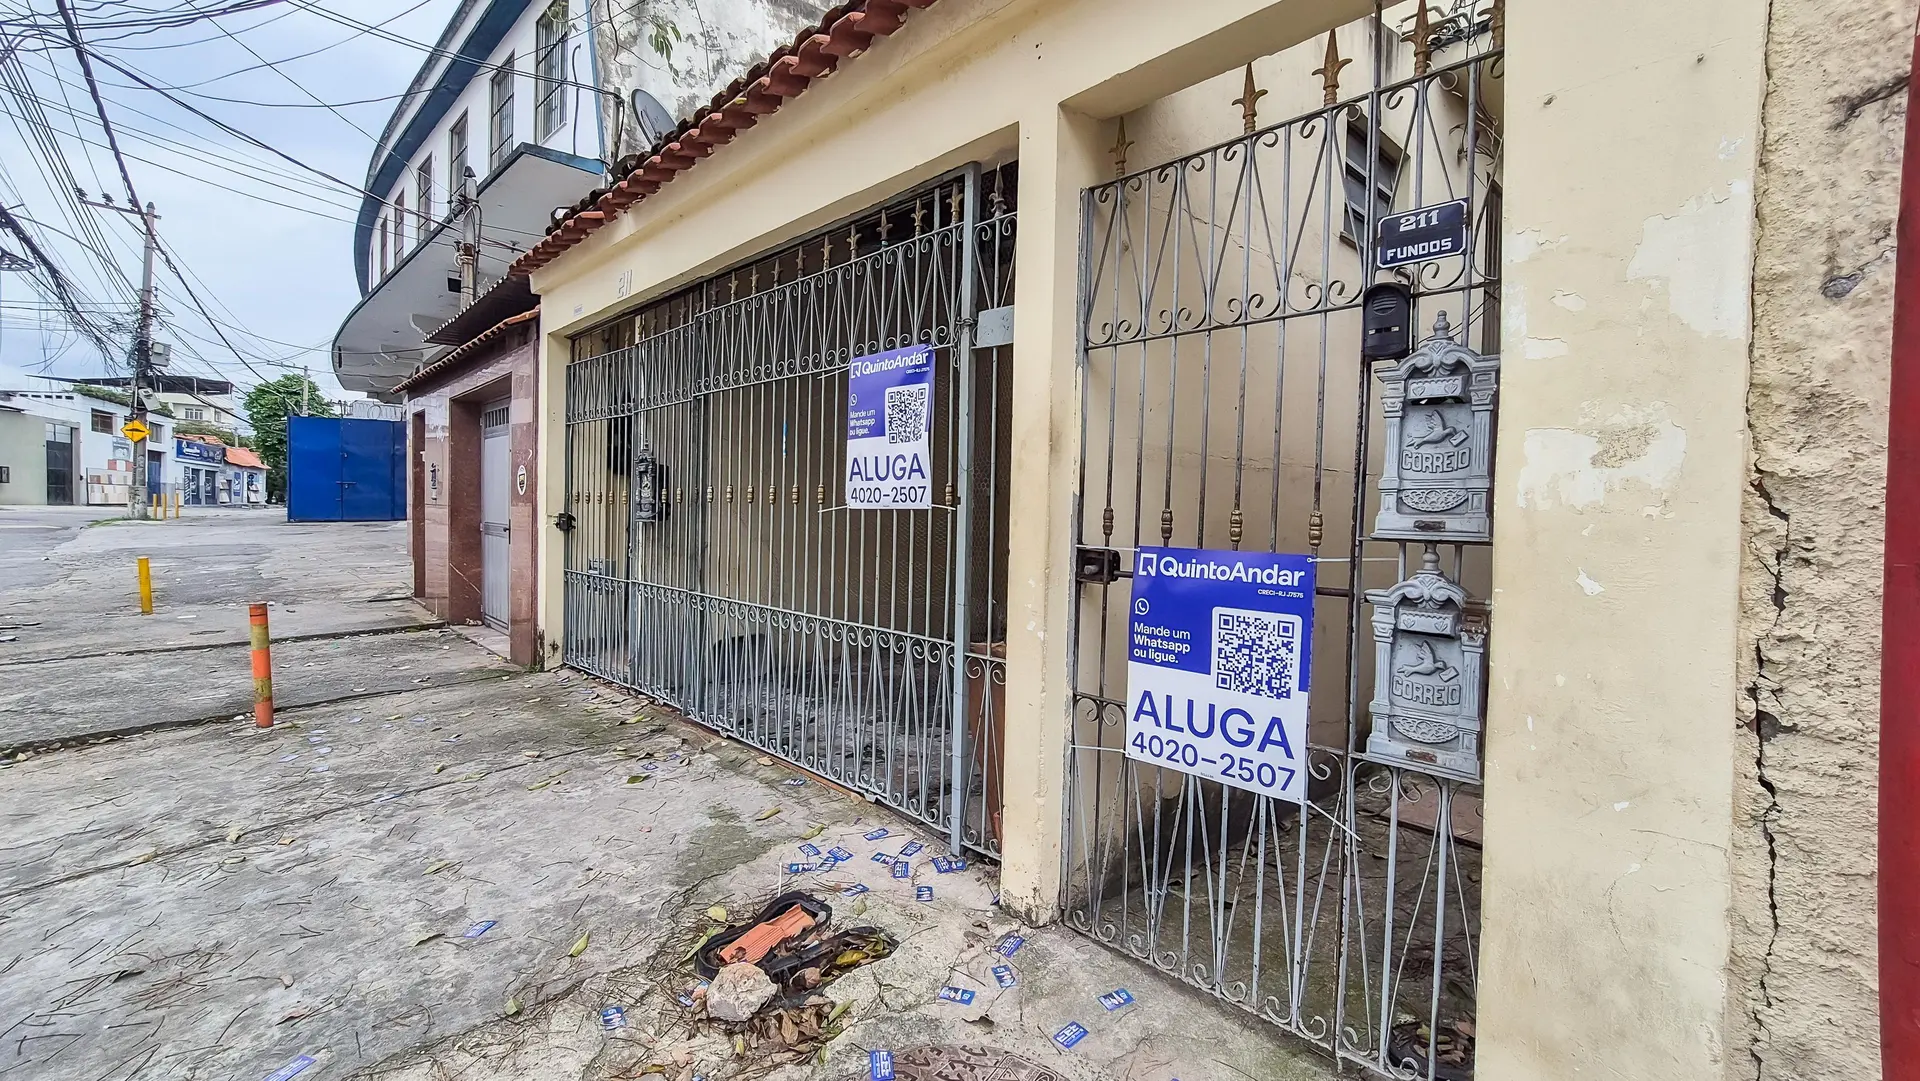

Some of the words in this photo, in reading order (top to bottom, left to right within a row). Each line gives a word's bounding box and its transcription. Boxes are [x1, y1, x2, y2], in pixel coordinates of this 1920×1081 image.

[1399, 209, 1440, 232] 211
[1386, 237, 1452, 261] FUNDOS
[862, 351, 929, 375] QuintoAndar
[849, 453, 926, 482] ALUGA
[1402, 447, 1471, 474] CORREIO
[850, 485, 927, 504] 4020-2507
[1159, 556, 1305, 587] QuintoAndar
[1257, 589, 1286, 597] CRECI-RJ
[1134, 622, 1171, 638] Mande
[1172, 630, 1191, 640] um
[1133, 634, 1191, 655] Whatsapp
[1133, 648, 1147, 658] ou
[1148, 649, 1179, 664] ligue.
[1392, 674, 1461, 706] CORREIO
[1132, 690, 1295, 760] ALUGA
[1131, 731, 1296, 792] 4020-2507
